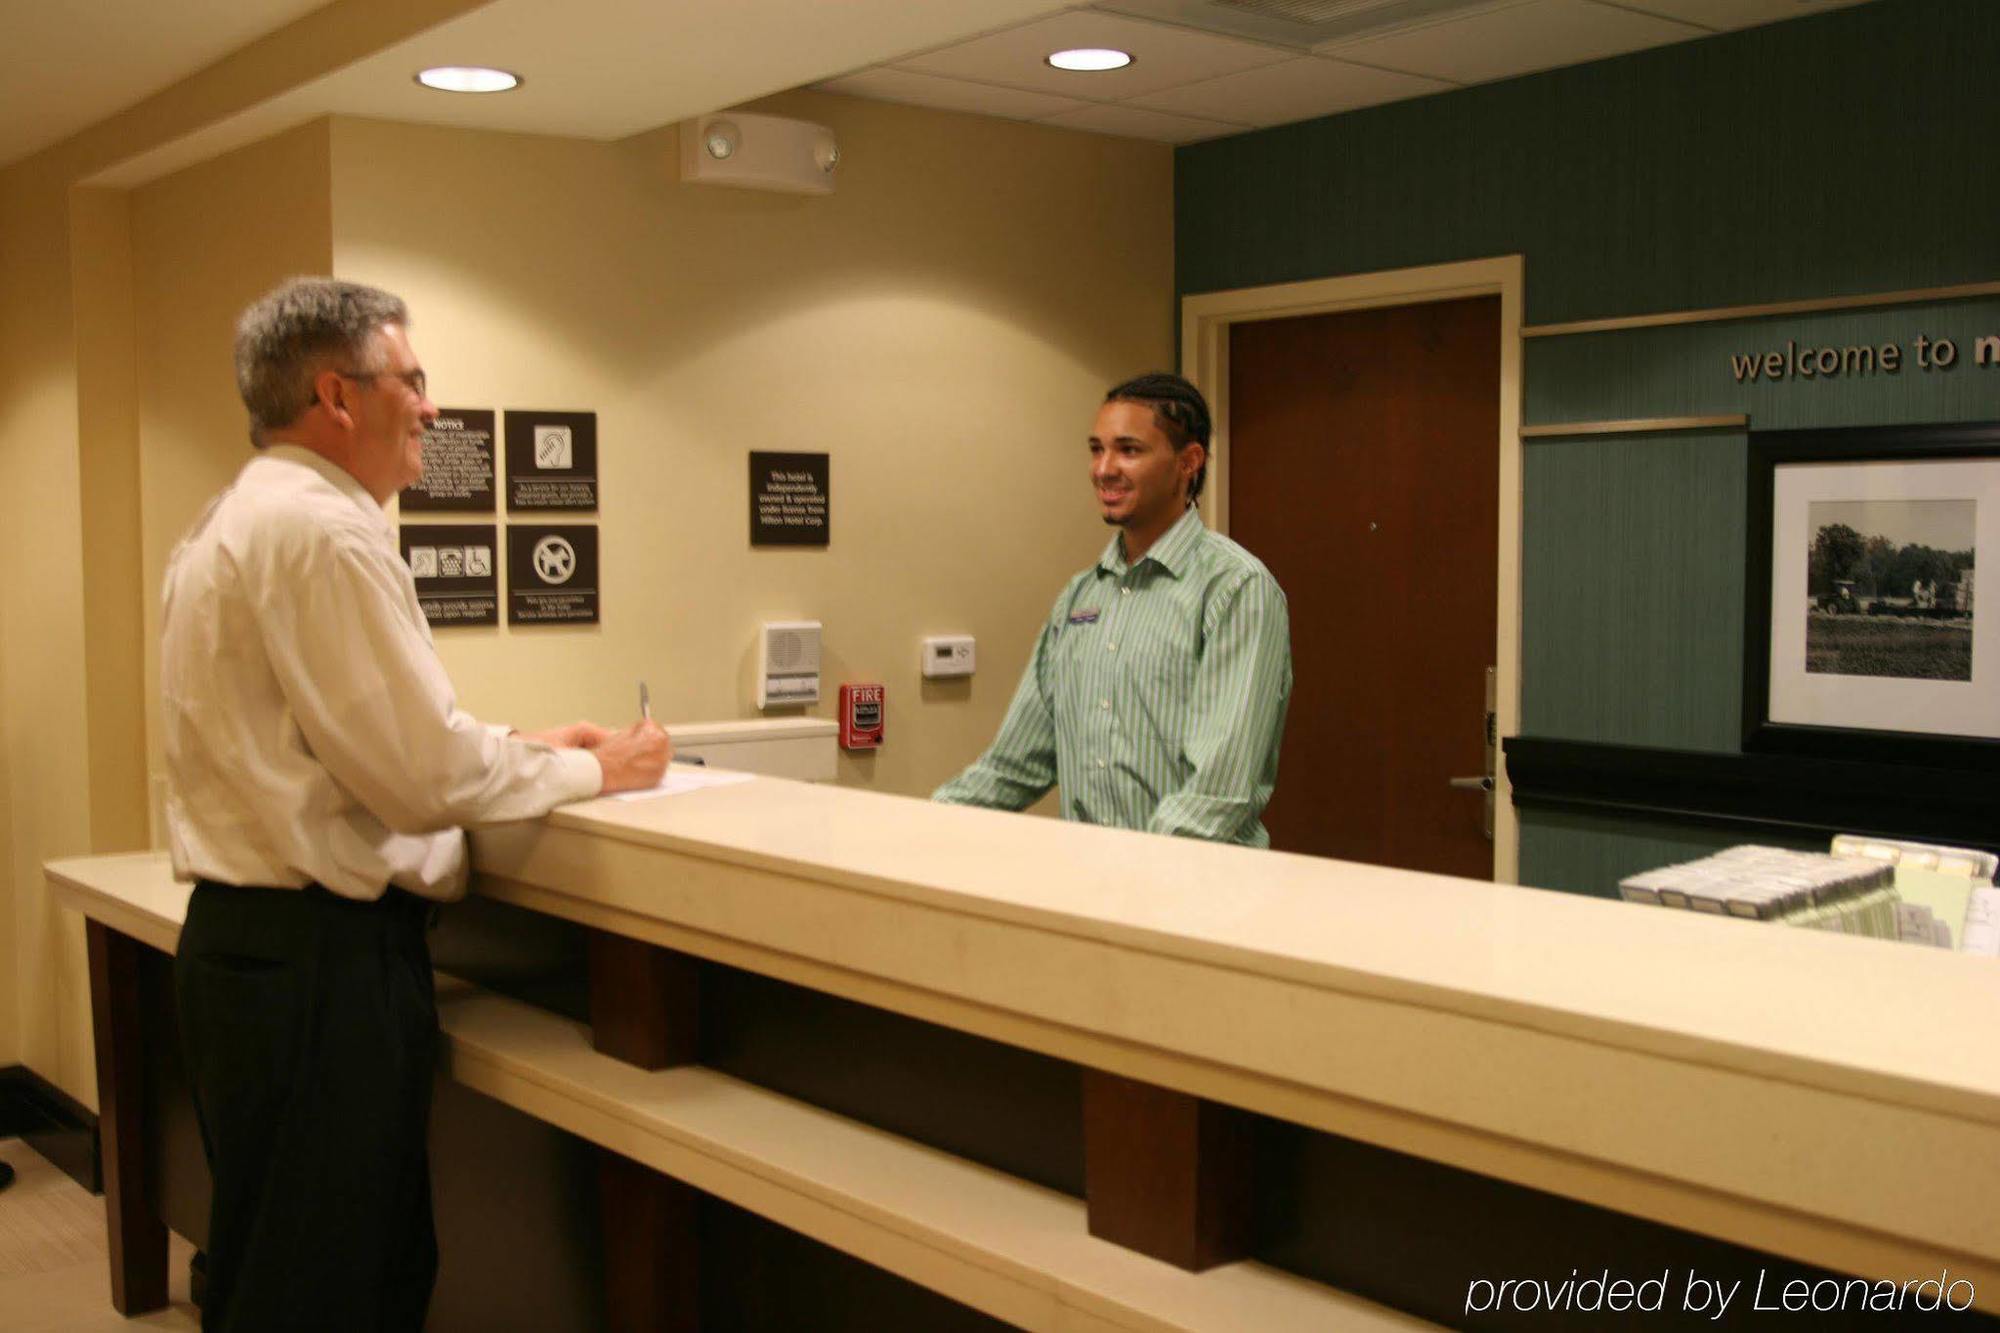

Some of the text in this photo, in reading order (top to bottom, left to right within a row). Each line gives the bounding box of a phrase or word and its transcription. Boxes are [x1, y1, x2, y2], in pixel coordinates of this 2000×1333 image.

[1731, 340, 1900, 381] welcome
[1914, 335, 1957, 368] to
[787, 472, 807, 482] hotel
[852, 688, 881, 702] FIRE
